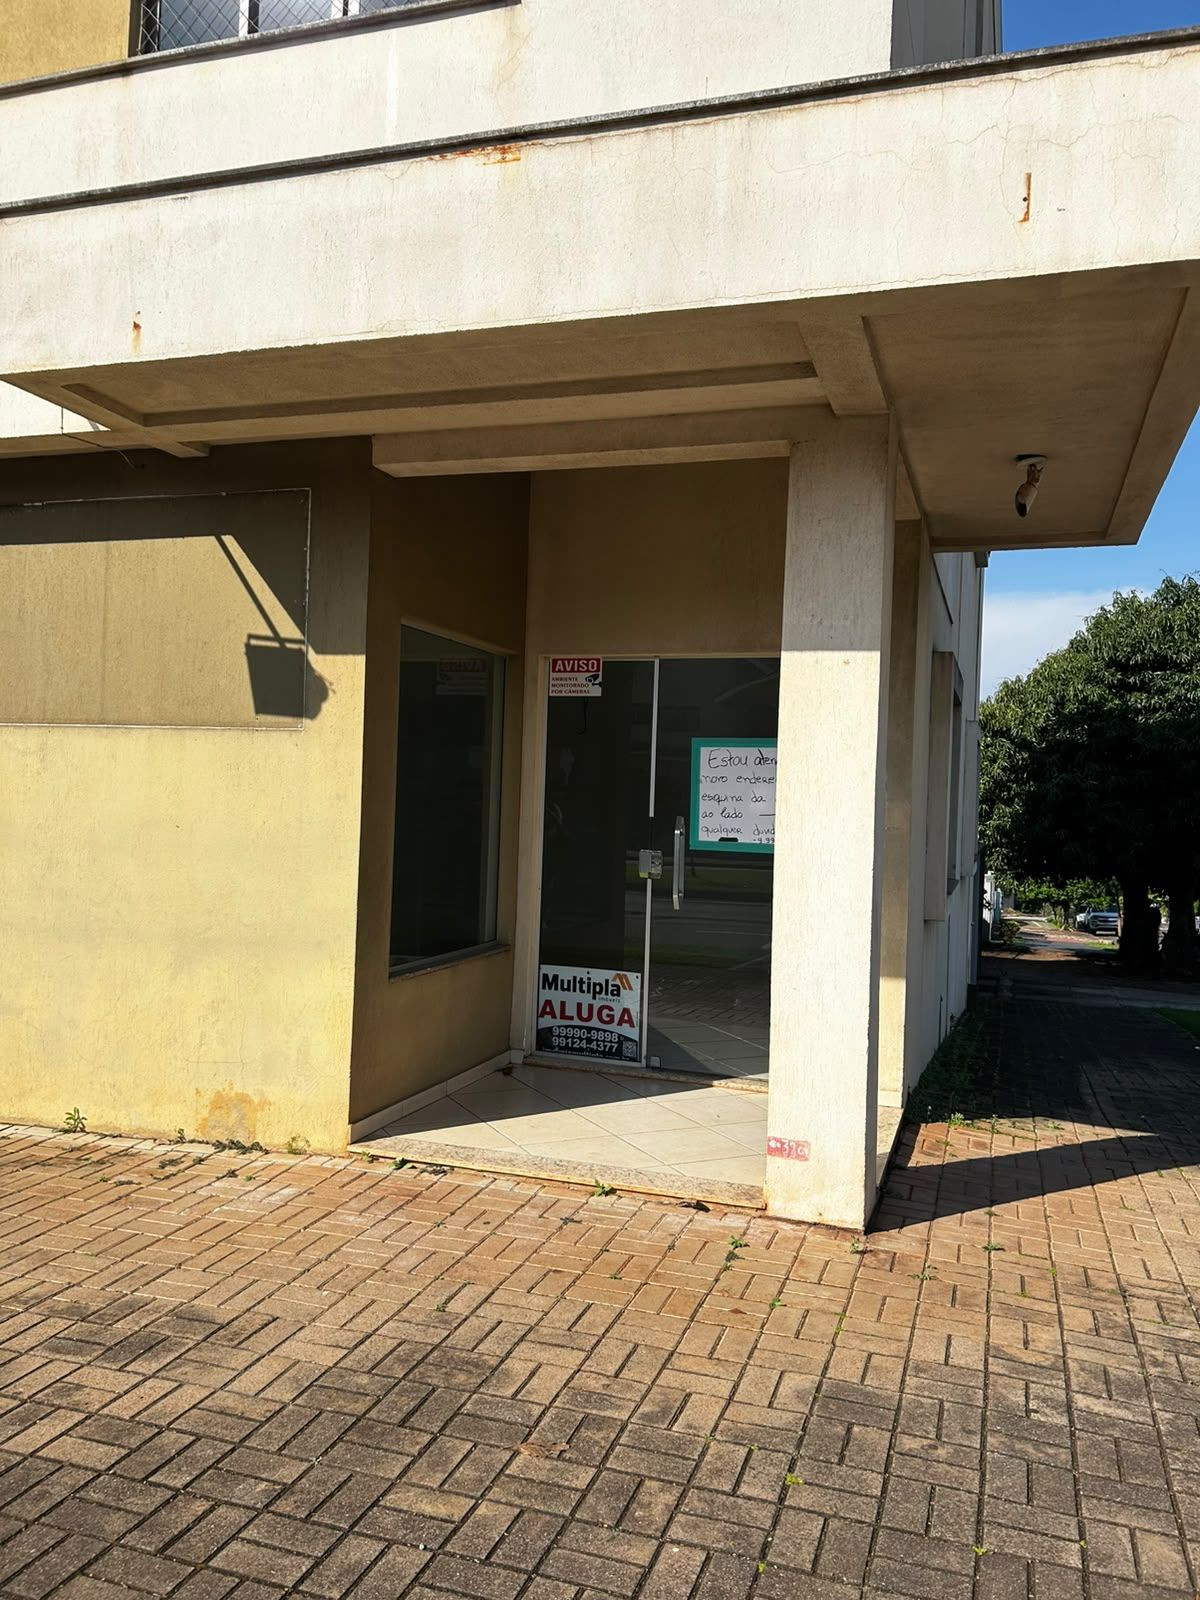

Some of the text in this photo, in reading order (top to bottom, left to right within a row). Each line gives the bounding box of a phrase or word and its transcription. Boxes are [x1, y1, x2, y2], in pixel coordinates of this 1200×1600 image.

[554, 659, 598, 672] AVISO
[708, 748, 777, 769] Estou aten
[736, 770, 776, 784] endere
[701, 792, 743, 806] esquina
[701, 811, 714, 819] ao
[541, 973, 621, 1000] Multipla
[538, 999, 635, 1028] ALUGA
[552, 1026, 619, 1042] 99990-9898
[552, 1036, 618, 1053] 99124-4377
